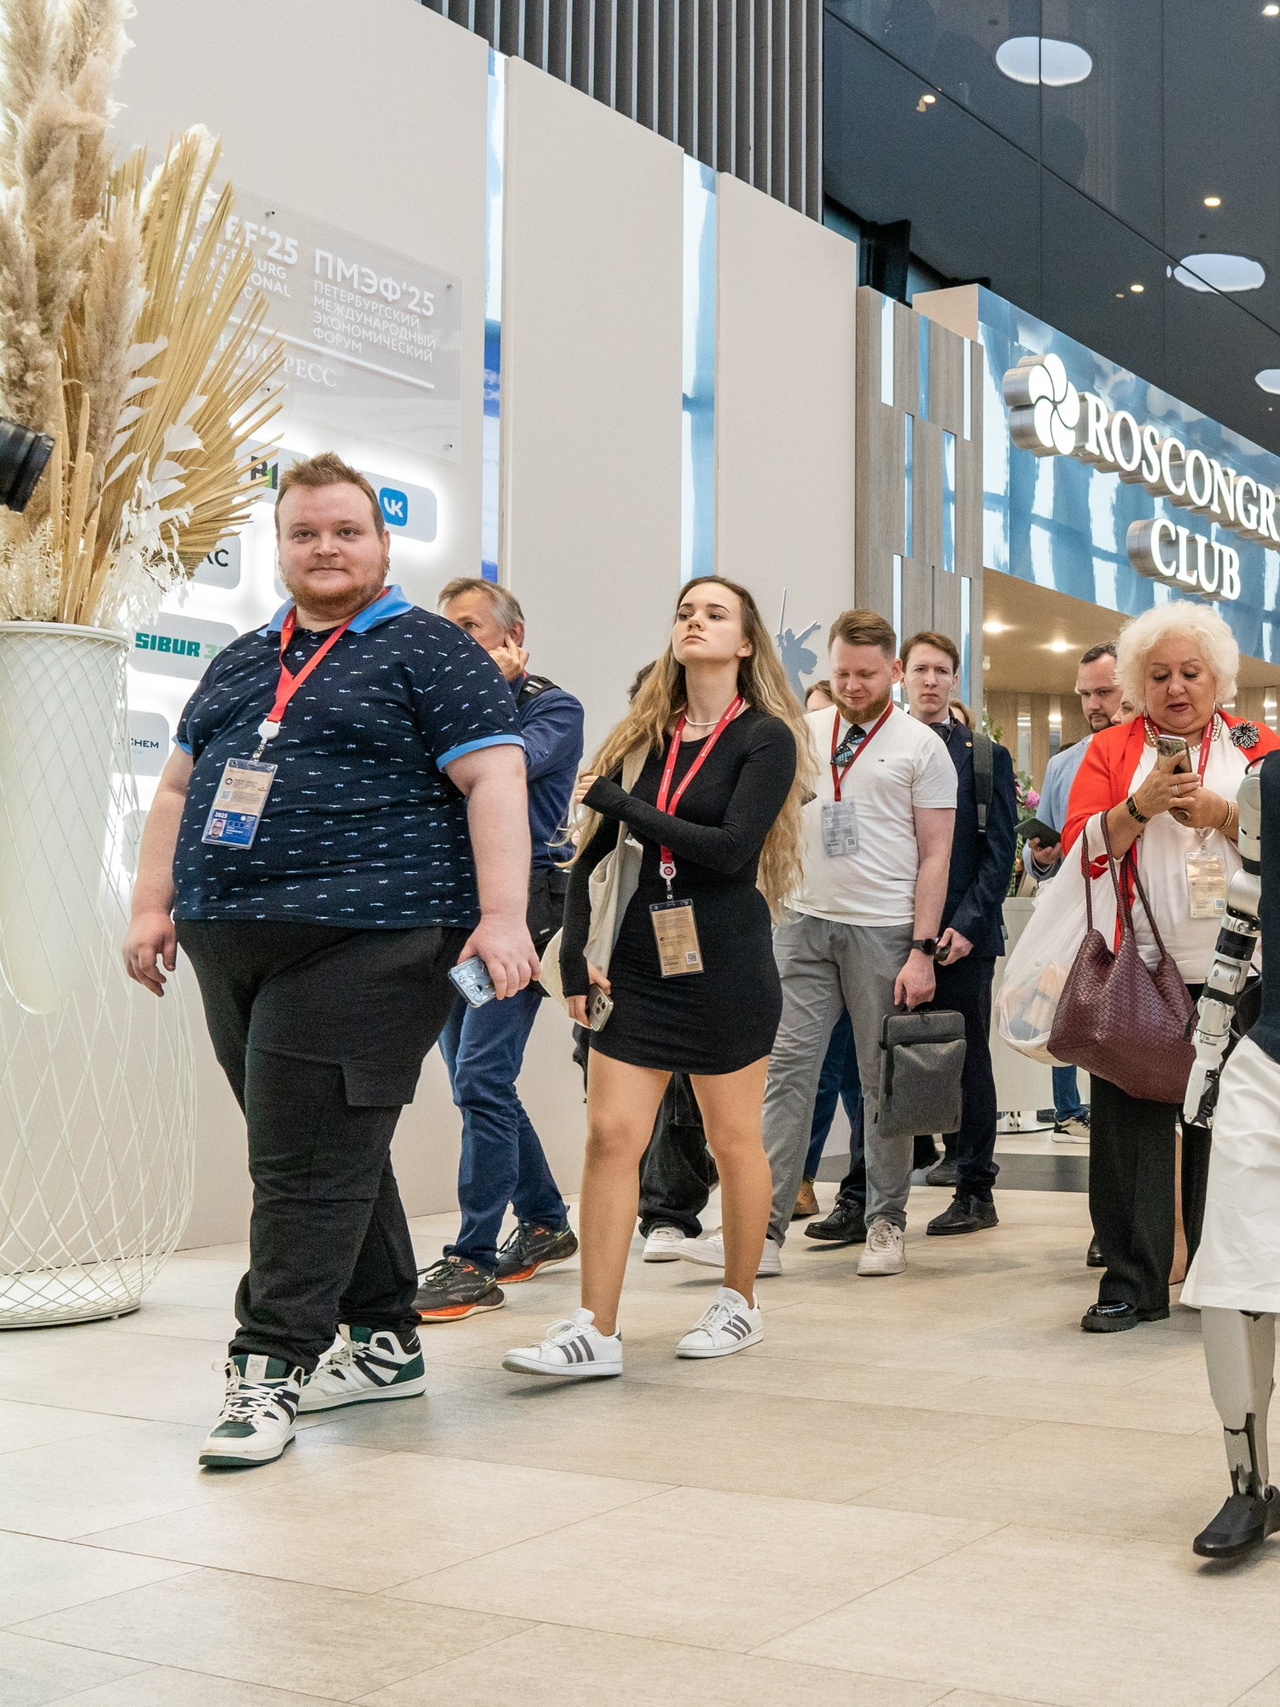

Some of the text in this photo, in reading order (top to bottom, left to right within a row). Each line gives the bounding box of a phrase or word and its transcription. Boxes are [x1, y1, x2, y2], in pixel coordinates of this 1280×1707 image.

[313, 295, 436, 349] МЕЖДУНАРОДНЫЙ
[314, 280, 420, 329] ПЕТЕРБУРГСКИЙ
[313, 310, 433, 363] ЭКОНОМИЧЕСКИЙ
[313, 327, 362, 354] ФОРУМ
[383, 496, 404, 518] VK
[1150, 518, 1242, 601] CLUB
[135, 632, 201, 658] SIBUR
